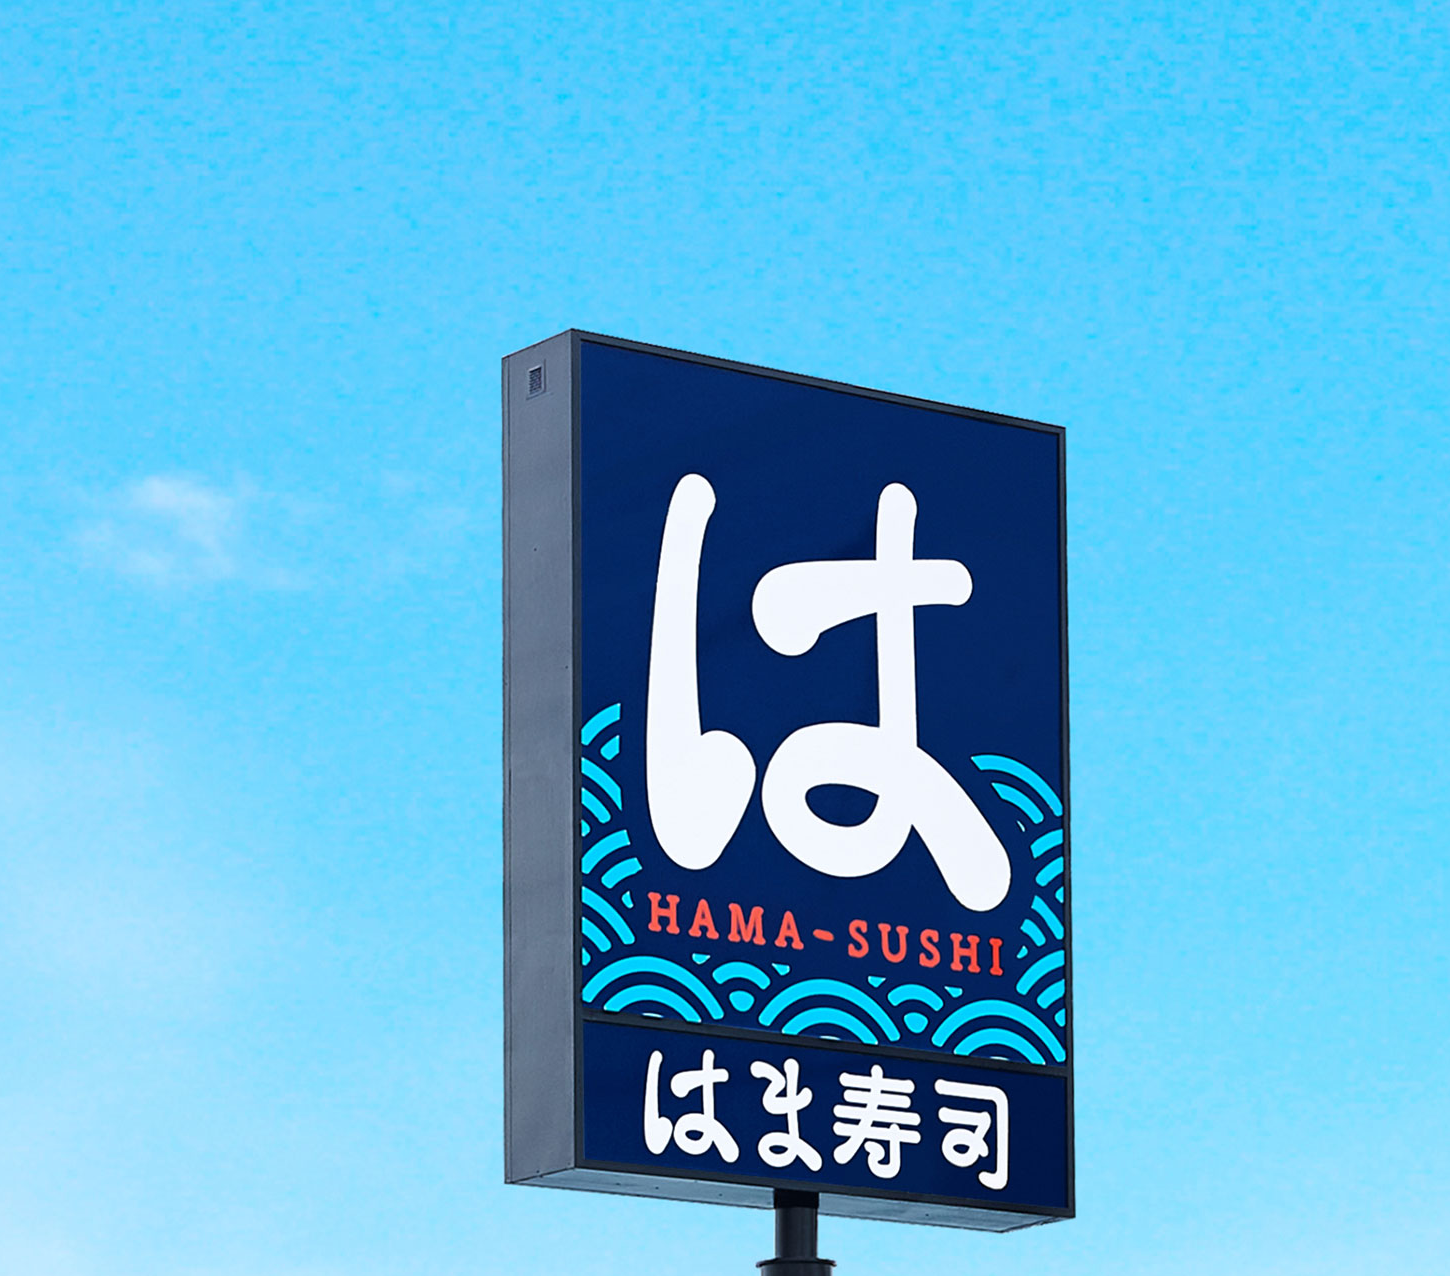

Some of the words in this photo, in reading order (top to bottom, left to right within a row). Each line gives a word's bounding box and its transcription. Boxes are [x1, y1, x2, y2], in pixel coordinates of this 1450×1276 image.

[646, 473, 1012, 911] は
[647, 891, 1004, 977] HAMA-SUSHI
[643, 1049, 1010, 1190] はま寿司
